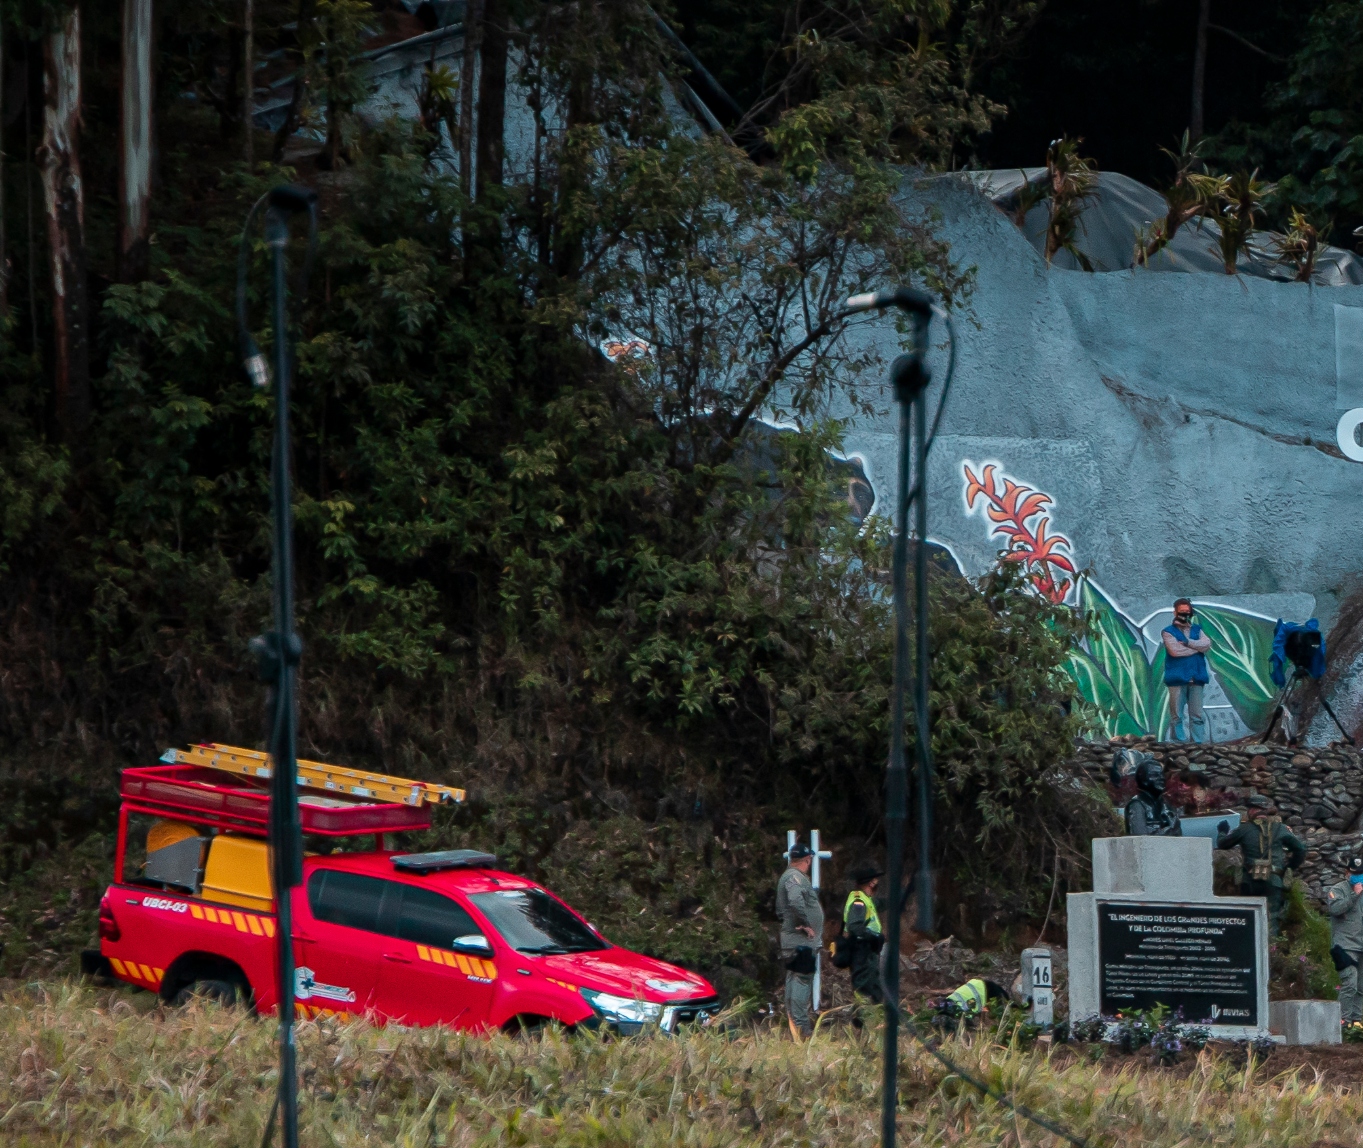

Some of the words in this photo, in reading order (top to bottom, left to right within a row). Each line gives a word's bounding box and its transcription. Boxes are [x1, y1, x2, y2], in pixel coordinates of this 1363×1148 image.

[142, 896, 188, 913] UBCI-03
[1153, 915, 1163, 923] DE
[1163, 915, 1177, 923] LOS
[1033, 966, 1050, 984] 16
[1222, 1008, 1250, 1017] INVIAS
